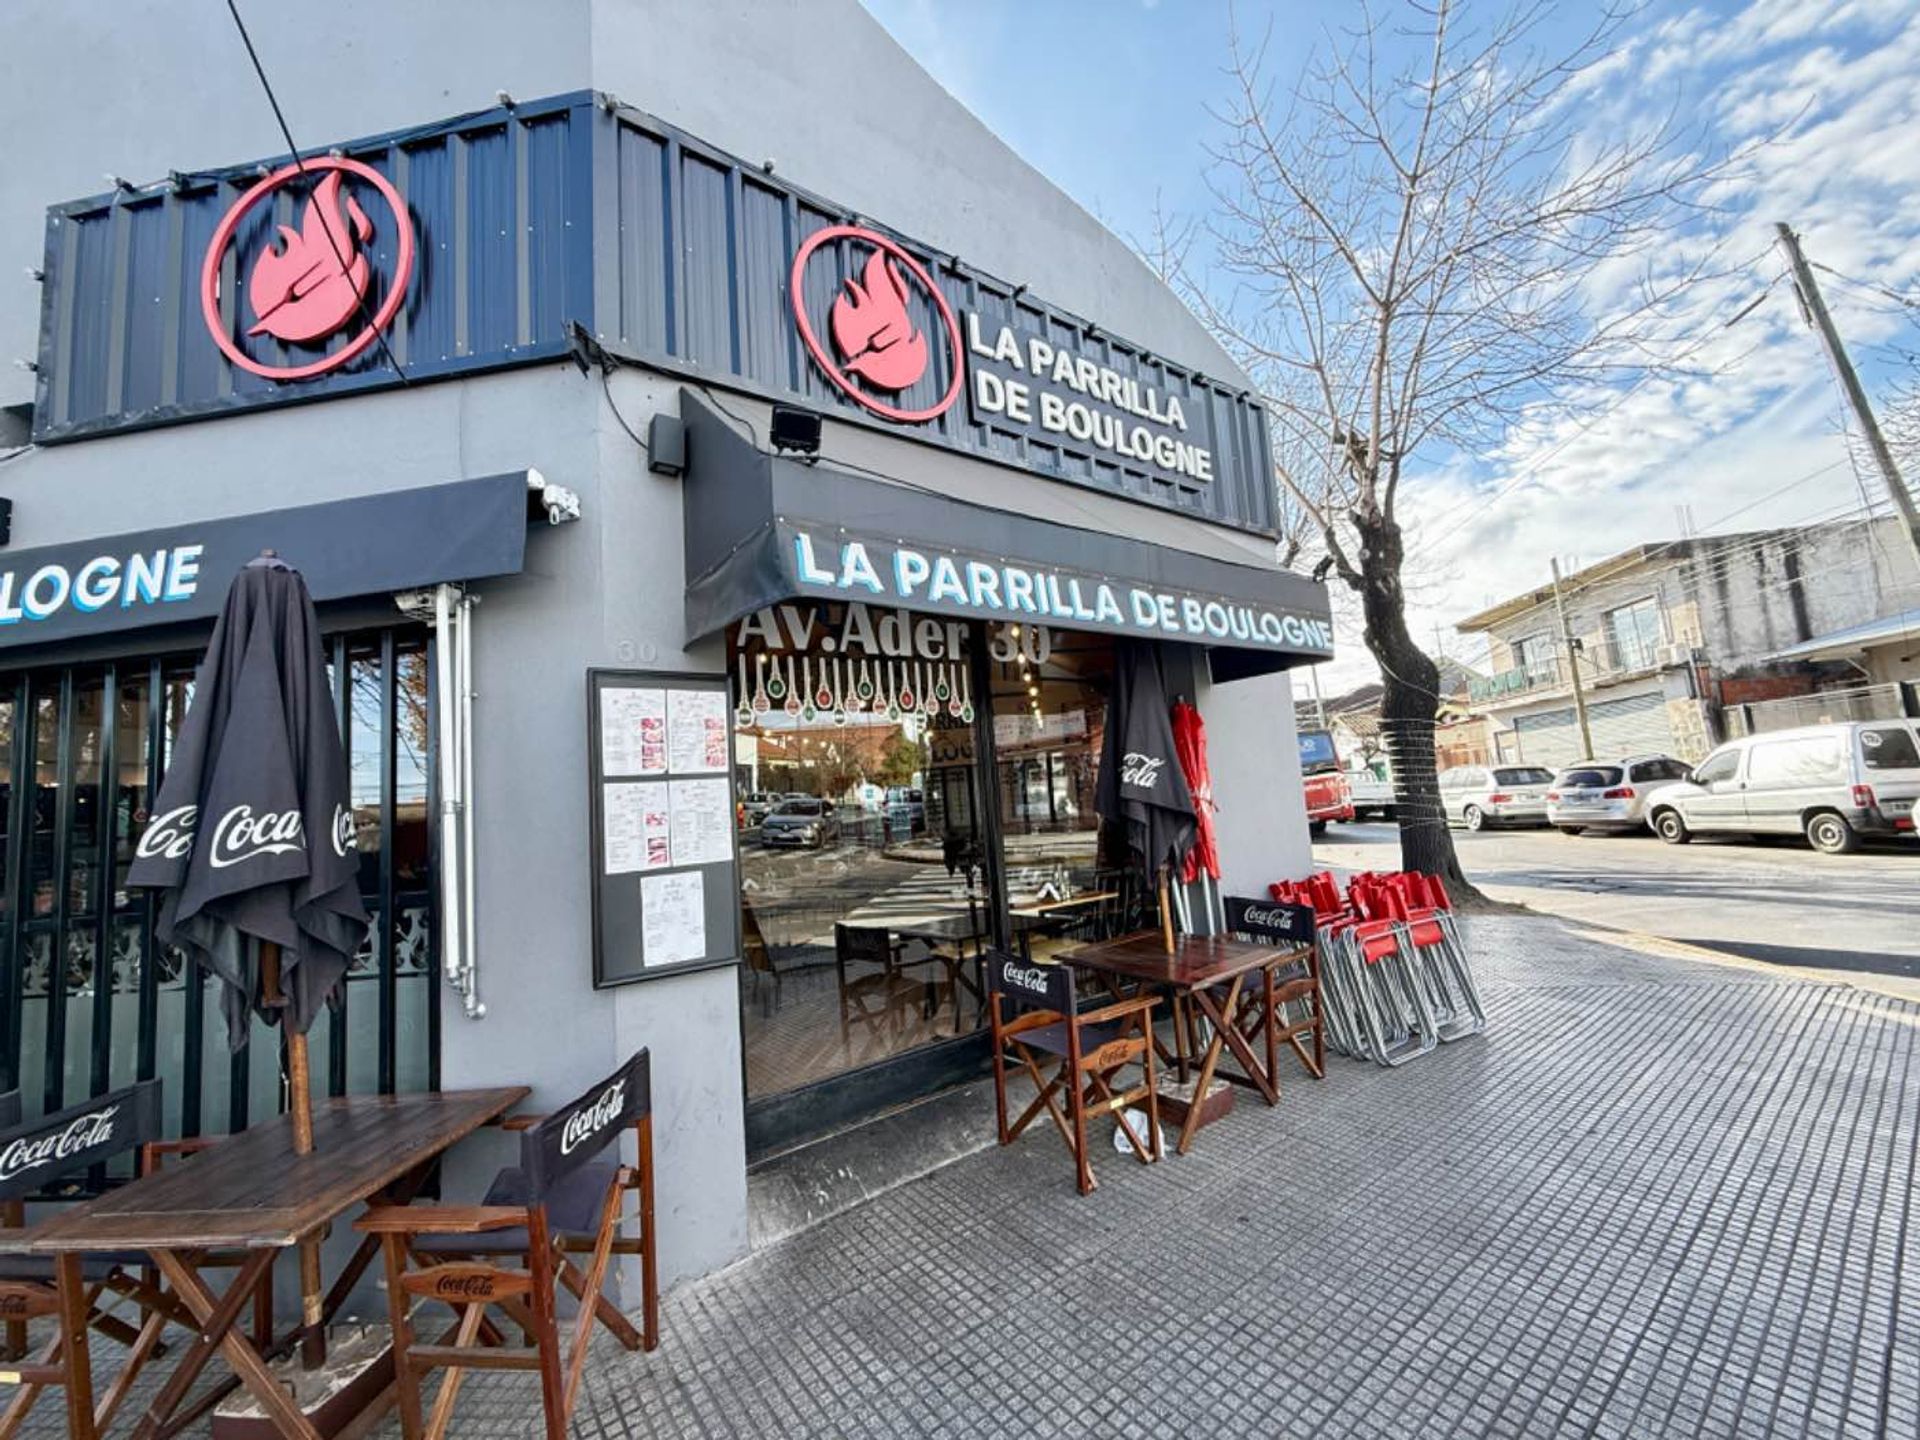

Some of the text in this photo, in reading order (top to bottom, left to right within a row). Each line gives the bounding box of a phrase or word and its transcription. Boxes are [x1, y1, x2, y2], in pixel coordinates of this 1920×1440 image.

[969, 312, 1188, 431] LA PARRILLA
[976, 369, 1214, 483] DE BOULOGNE
[0, 544, 204, 624] LOGNE
[795, 531, 1333, 649] LA PARRILLA DE BOULOGNE
[989, 619, 1050, 664] 30
[209, 804, 306, 868] Coca
